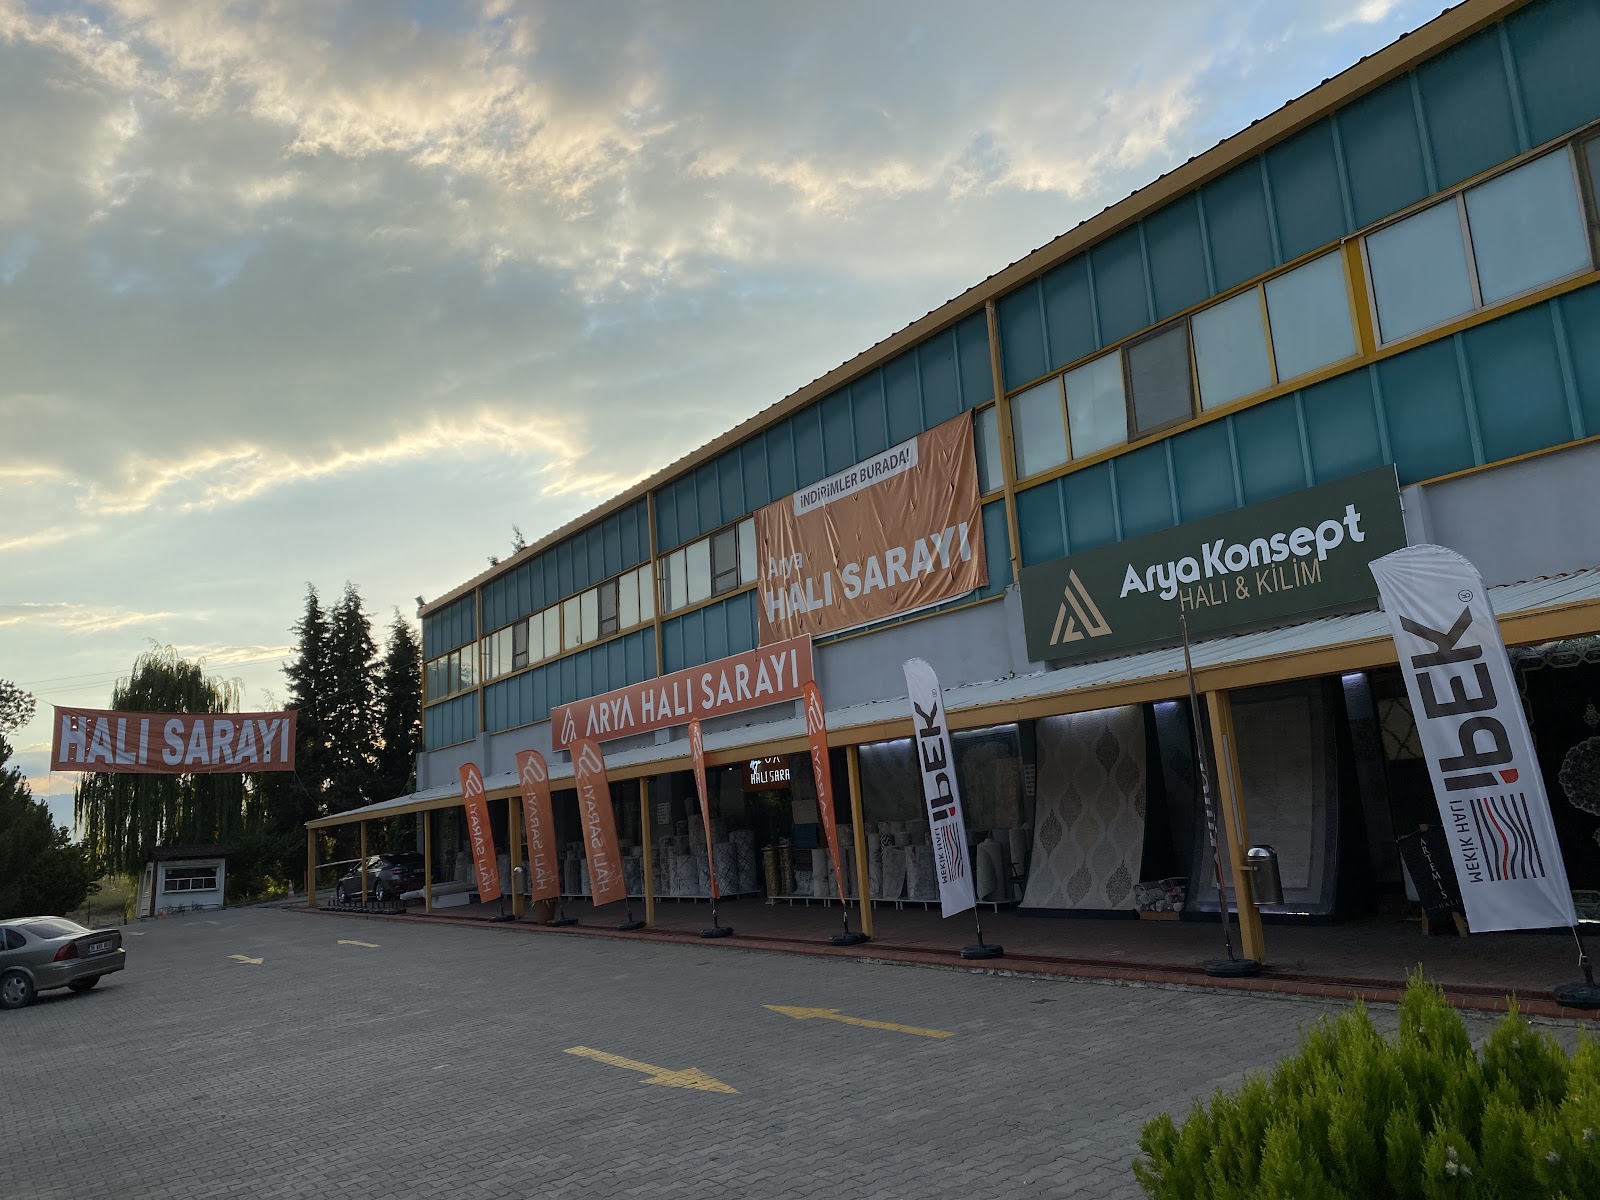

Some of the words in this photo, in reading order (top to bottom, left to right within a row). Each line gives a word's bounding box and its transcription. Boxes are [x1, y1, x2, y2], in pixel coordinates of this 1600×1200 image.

[860, 447, 910, 483] BURADA!
[766, 571, 833, 623] HALI
[842, 521, 971, 600] SARAYI
[767, 551, 803, 581] Arya
[1179, 581, 1229, 612] HALI
[1235, 576, 1250, 600] &
[1256, 558, 1322, 596] KİLİM
[586, 695, 635, 736] ARYA
[641, 678, 693, 724] HALI
[701, 649, 799, 710] SARAYI
[58, 714, 149, 765] HALI
[162, 717, 290, 765] SARAYI
[751, 771, 768, 785] HALI
[1420, 837, 1448, 900] ARTEMIS
